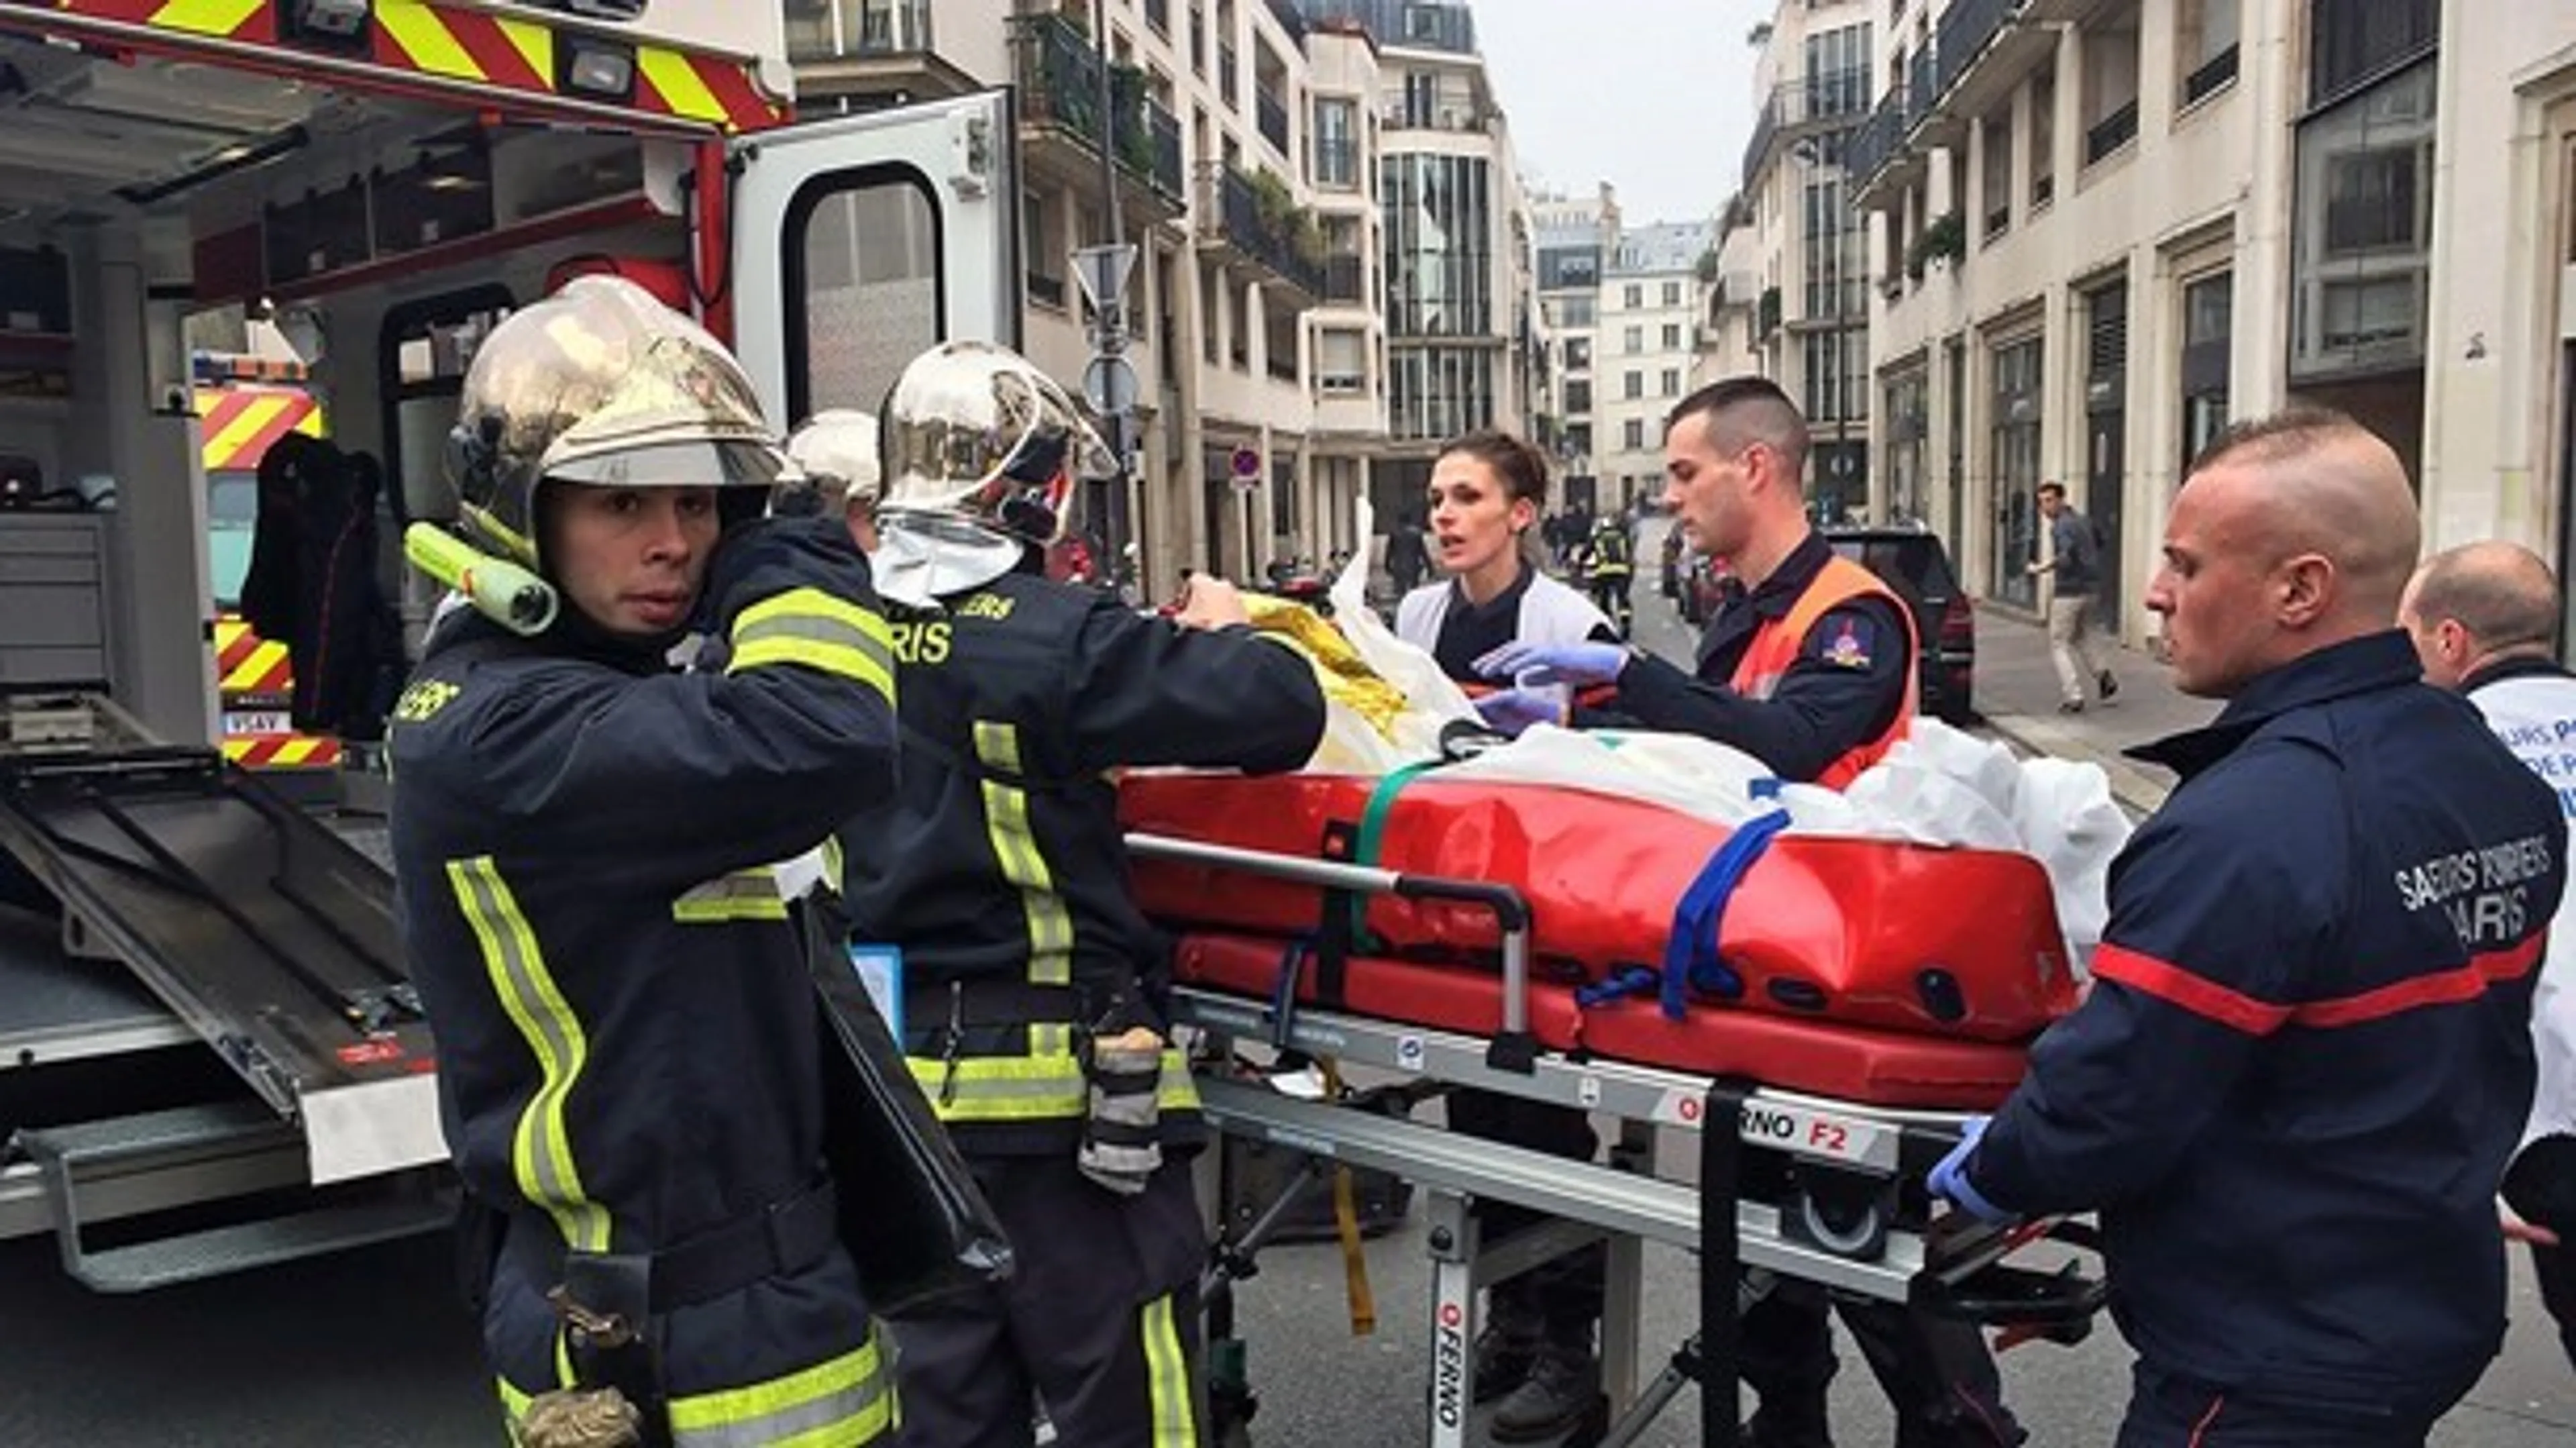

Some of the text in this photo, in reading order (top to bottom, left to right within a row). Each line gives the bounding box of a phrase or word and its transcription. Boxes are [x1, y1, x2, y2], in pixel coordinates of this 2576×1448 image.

[955, 593, 1016, 621] ERS
[1809, 1121, 1847, 1150] F2
[1438, 1327, 1462, 1428] FERNO
